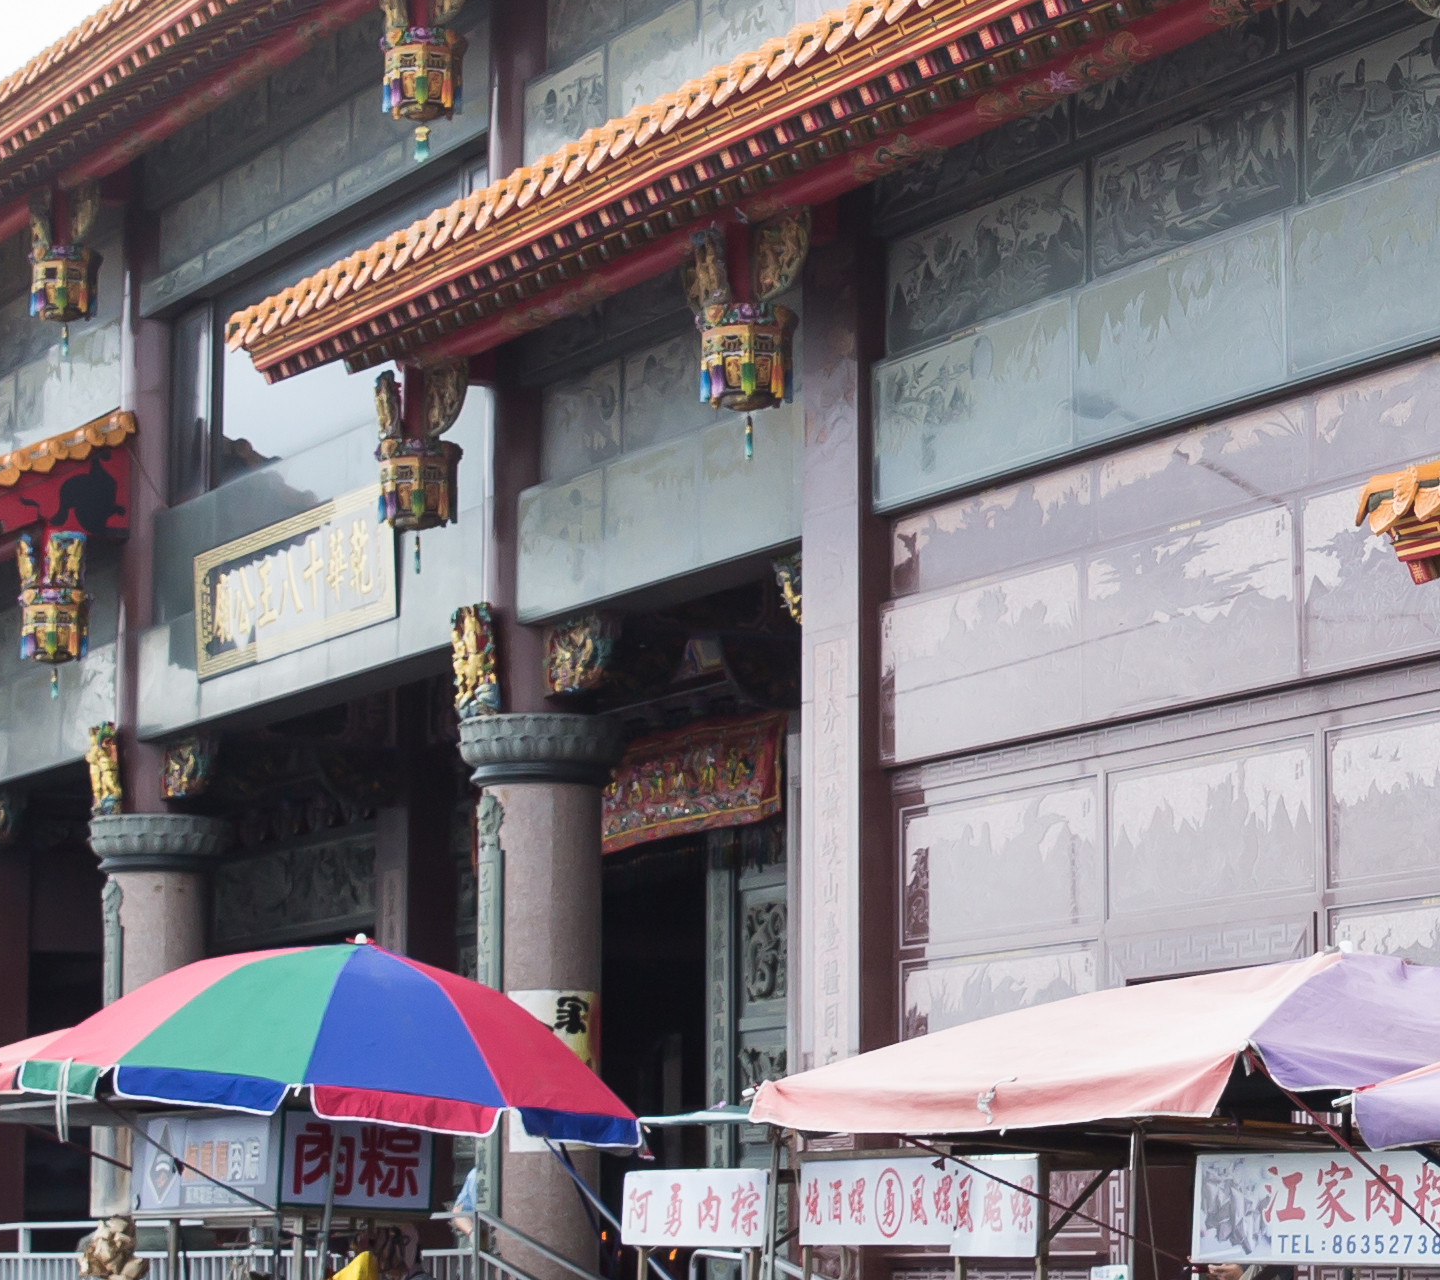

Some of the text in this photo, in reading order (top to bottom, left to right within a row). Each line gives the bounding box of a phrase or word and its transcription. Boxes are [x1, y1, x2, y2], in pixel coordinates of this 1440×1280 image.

[291, 1121, 422, 1199] 肉粽
[628, 1181, 762, 1237] 阿勇肉粽
